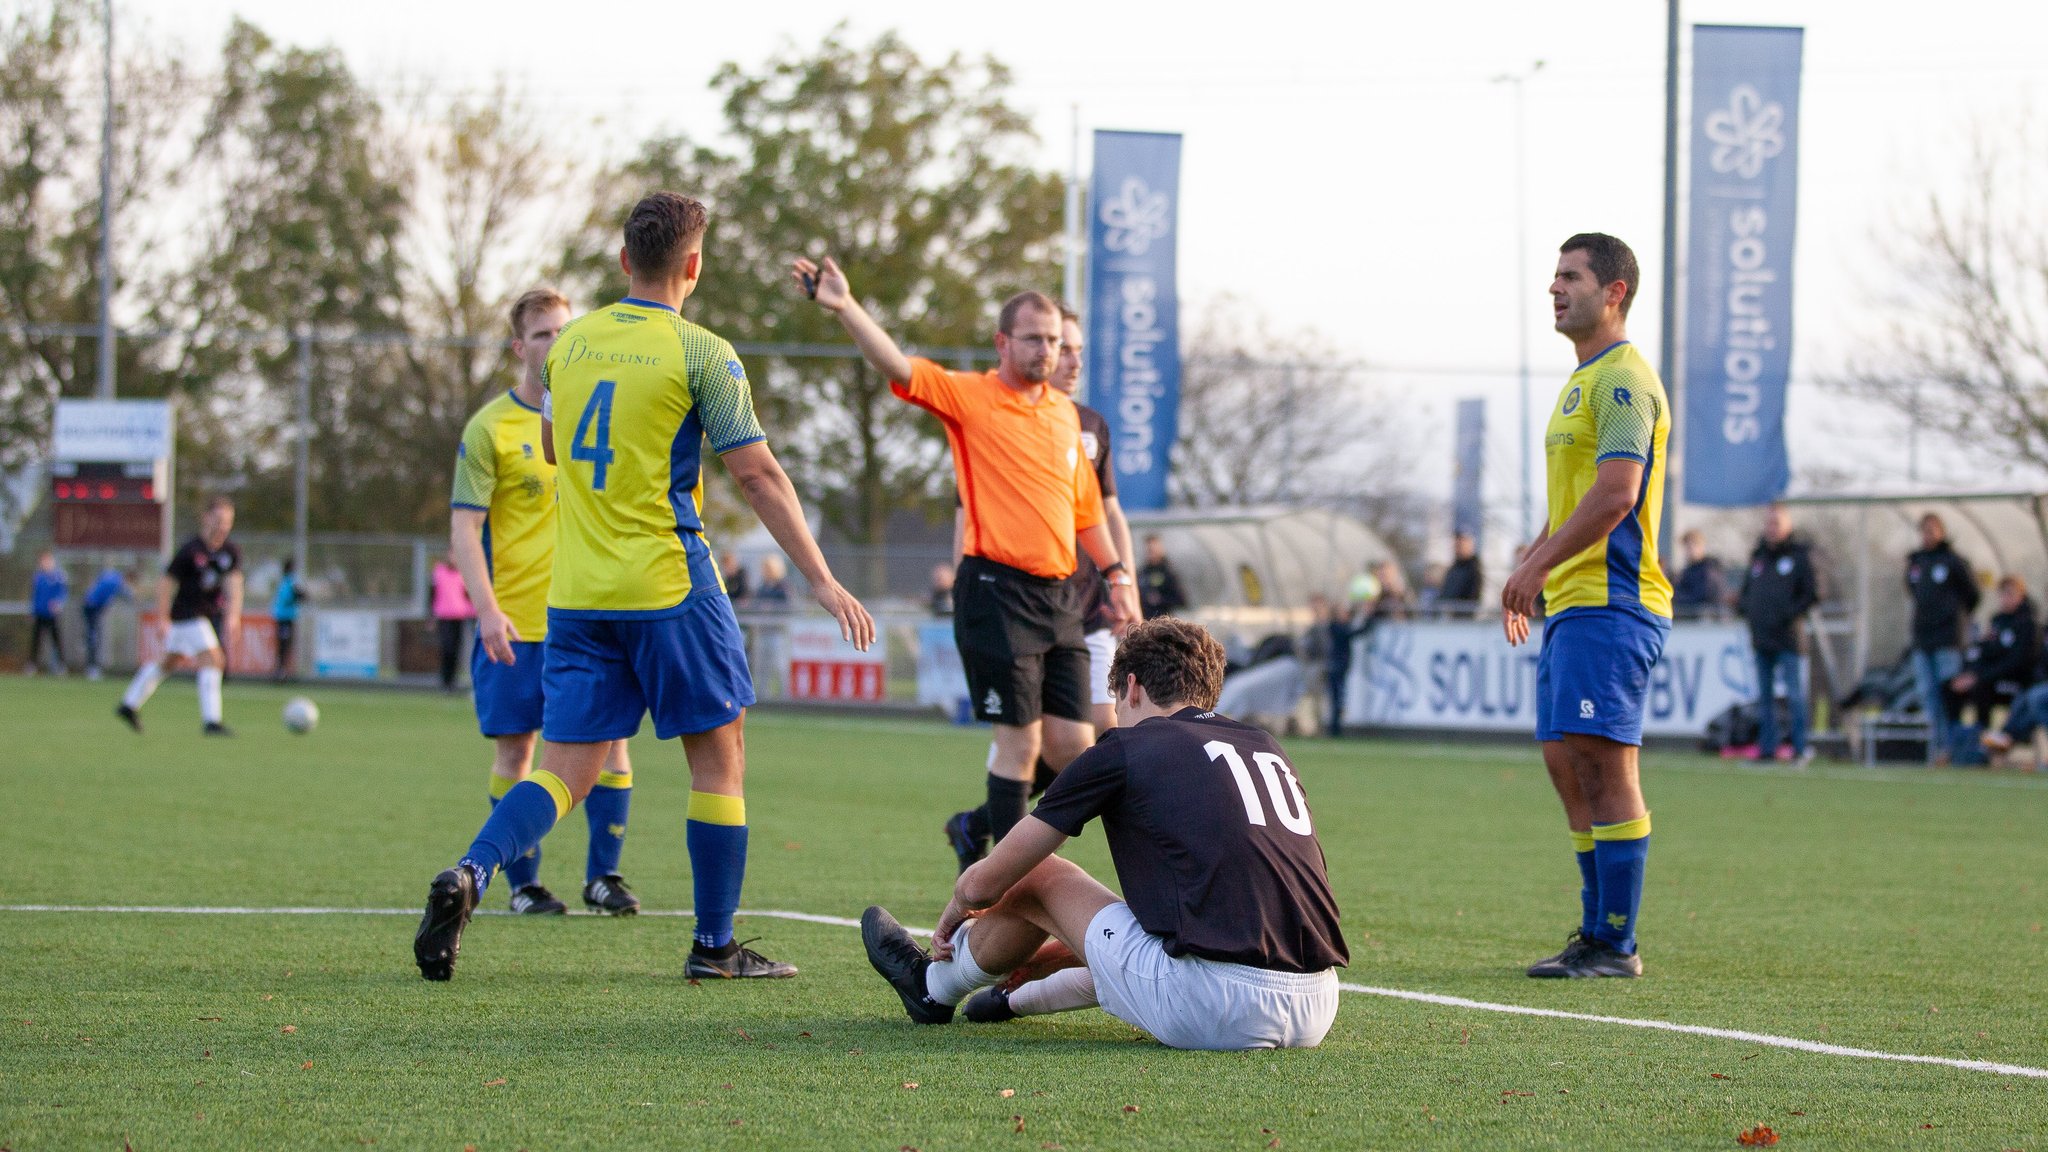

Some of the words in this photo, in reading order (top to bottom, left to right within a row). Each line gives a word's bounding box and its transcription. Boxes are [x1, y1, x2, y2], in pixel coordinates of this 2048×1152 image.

[610, 351, 662, 367] CLINIC
[1118, 276, 1167, 476] solutions
[1722, 204, 1775, 446] solutions
[570, 379, 618, 492] 4
[1650, 655, 1705, 720] BV
[1202, 740, 1313, 836] 10
